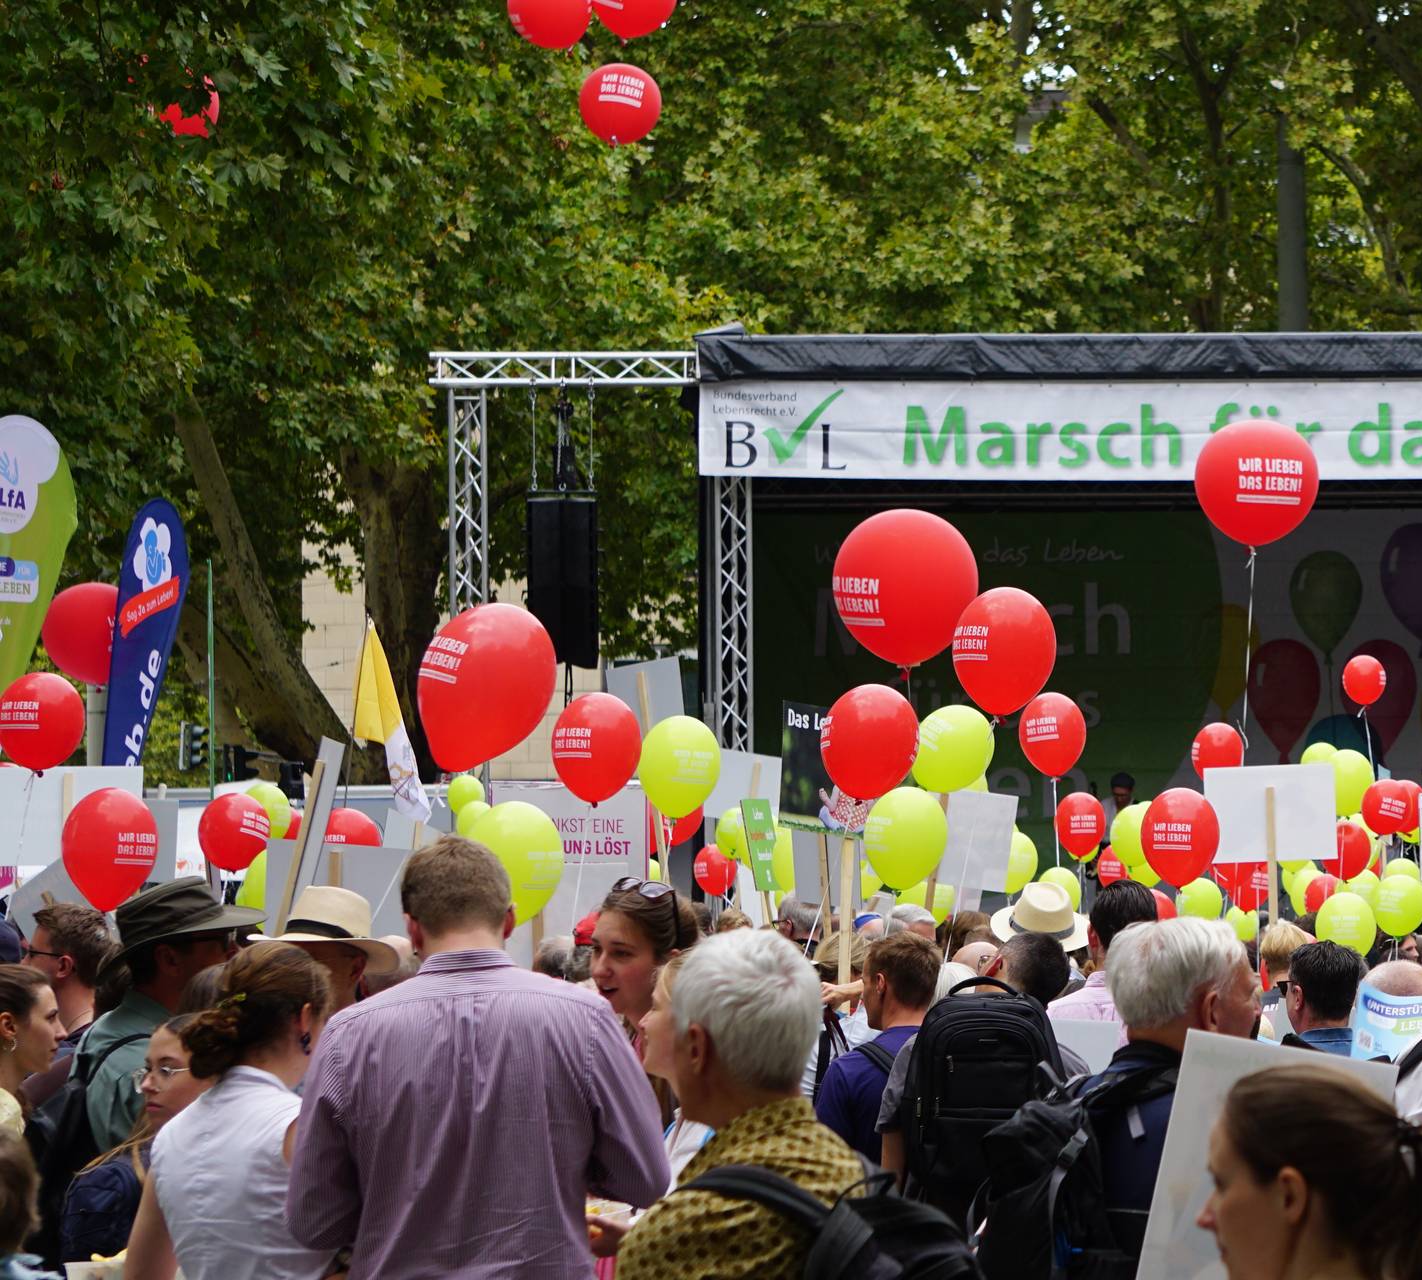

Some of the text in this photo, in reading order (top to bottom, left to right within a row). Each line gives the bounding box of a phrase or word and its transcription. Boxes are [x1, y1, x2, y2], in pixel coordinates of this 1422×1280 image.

[602, 74, 645, 89] WIR LIEBEN
[601, 83, 643, 99] DAS LEBEN!
[713, 390, 797, 402] Bundesverband
[712, 404, 798, 417] Lebensrecht e.V.
[902, 403, 1182, 468] Marsch
[1238, 457, 1303, 475] WIR LIEBEN
[1238, 476, 1303, 492] DAS LEBEN!
[841, 577, 879, 595] LIEBEN
[843, 598, 880, 614] LEBEN!
[962, 625, 988, 637] LIEBEN
[438, 637, 469, 655] LIEBEN
[961, 639, 987, 651] LEBEN!
[431, 652, 461, 670] LEBEN!
[14, 701, 39, 710] LIEBEN
[12, 712, 38, 721] LEBEN!
[788, 708, 810, 729] Das
[555, 728, 592, 738] WIR LIEBEN
[566, 739, 591, 749] LEBEN!
[593, 819, 624, 833] EINE
[1154, 823, 1192, 832] WIR LIEBEN
[118, 832, 156, 844] WIR LIEBEN
[1153, 833, 1191, 842] DAS LEBEN!
[118, 845, 135, 855] DAS
[596, 837, 631, 855] LÖST
